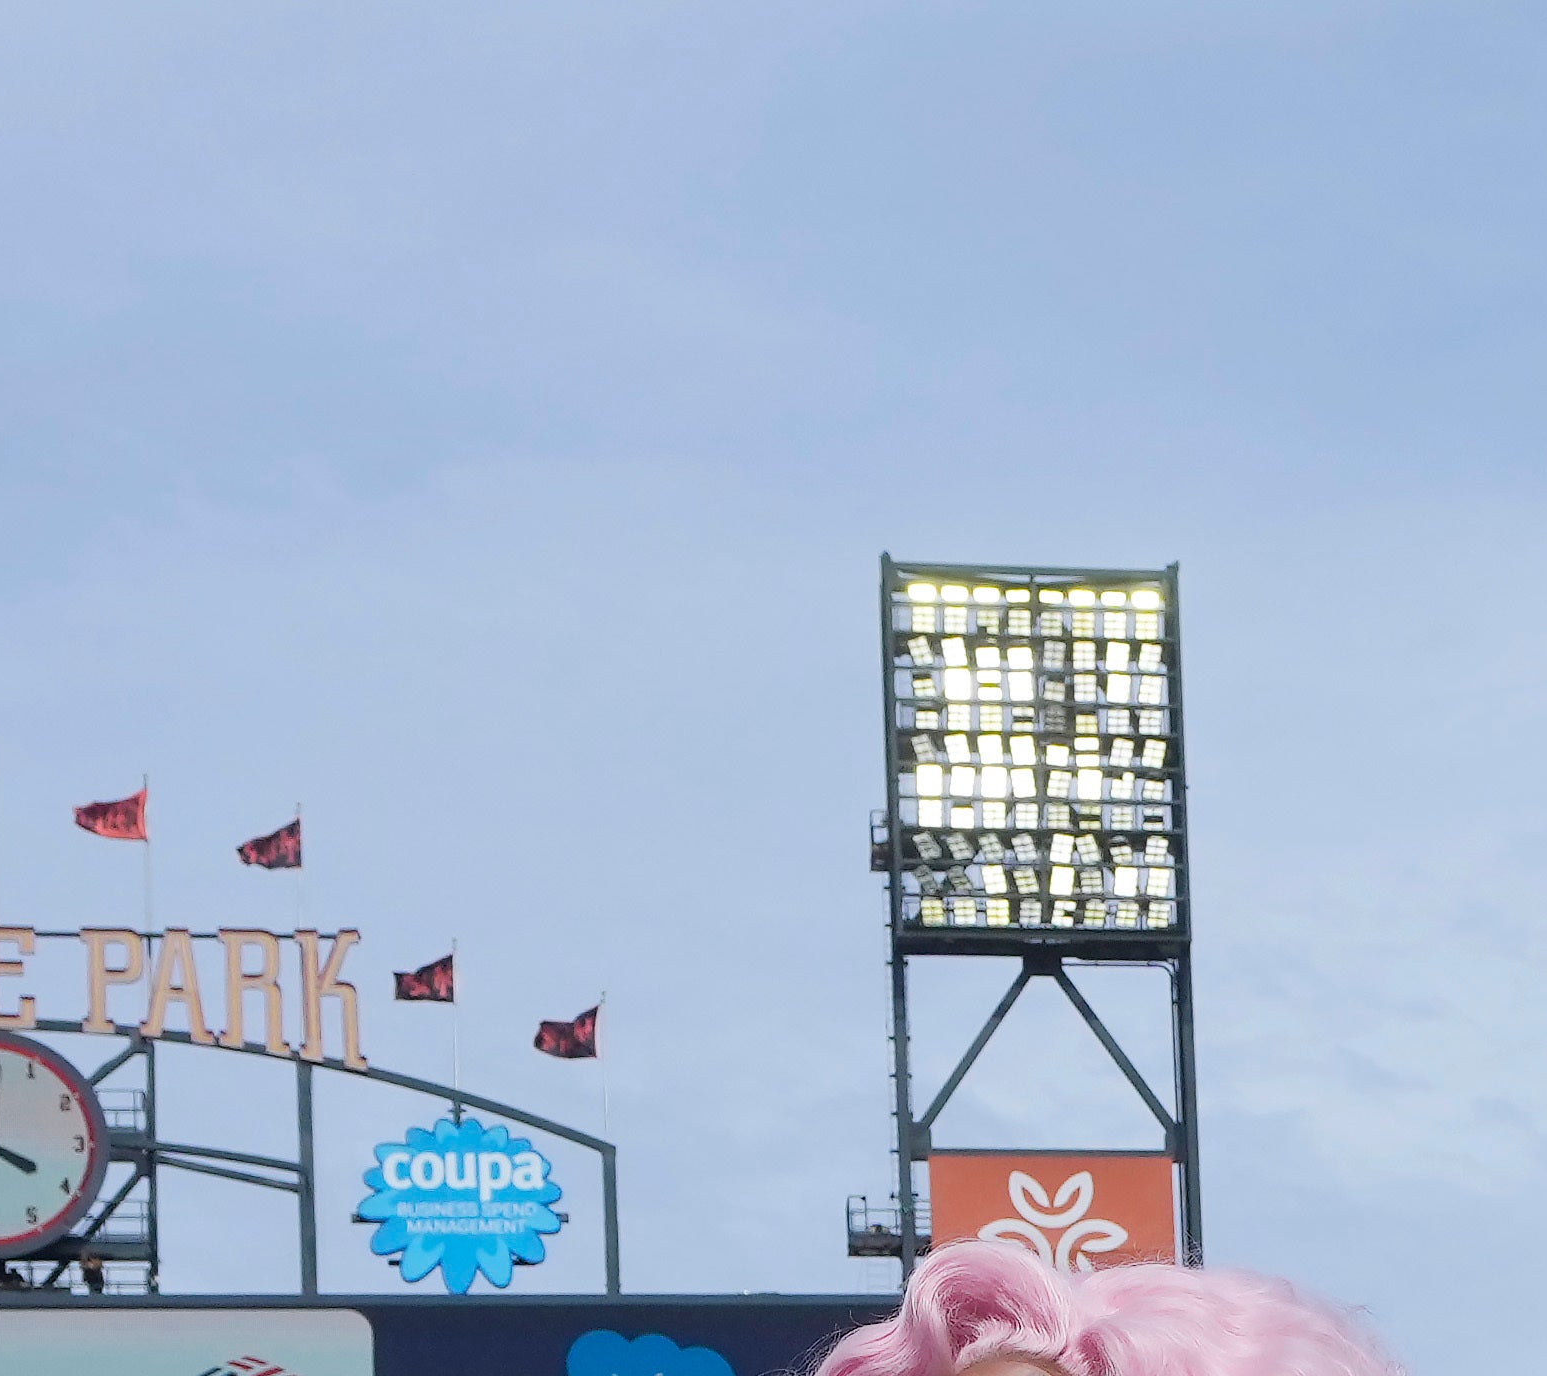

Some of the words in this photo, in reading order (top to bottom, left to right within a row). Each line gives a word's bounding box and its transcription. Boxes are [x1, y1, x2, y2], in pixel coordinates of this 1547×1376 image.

[79, 927, 368, 1072] PARK
[27, 1062, 36, 1080] 1
[60, 1094, 72, 1112] 2
[73, 1135, 85, 1153] 3
[382, 1150, 546, 1201] coupa
[59, 1177, 70, 1194] 4
[26, 1206, 37, 1225] 5
[406, 1217, 527, 1234] MANAGEMENT
